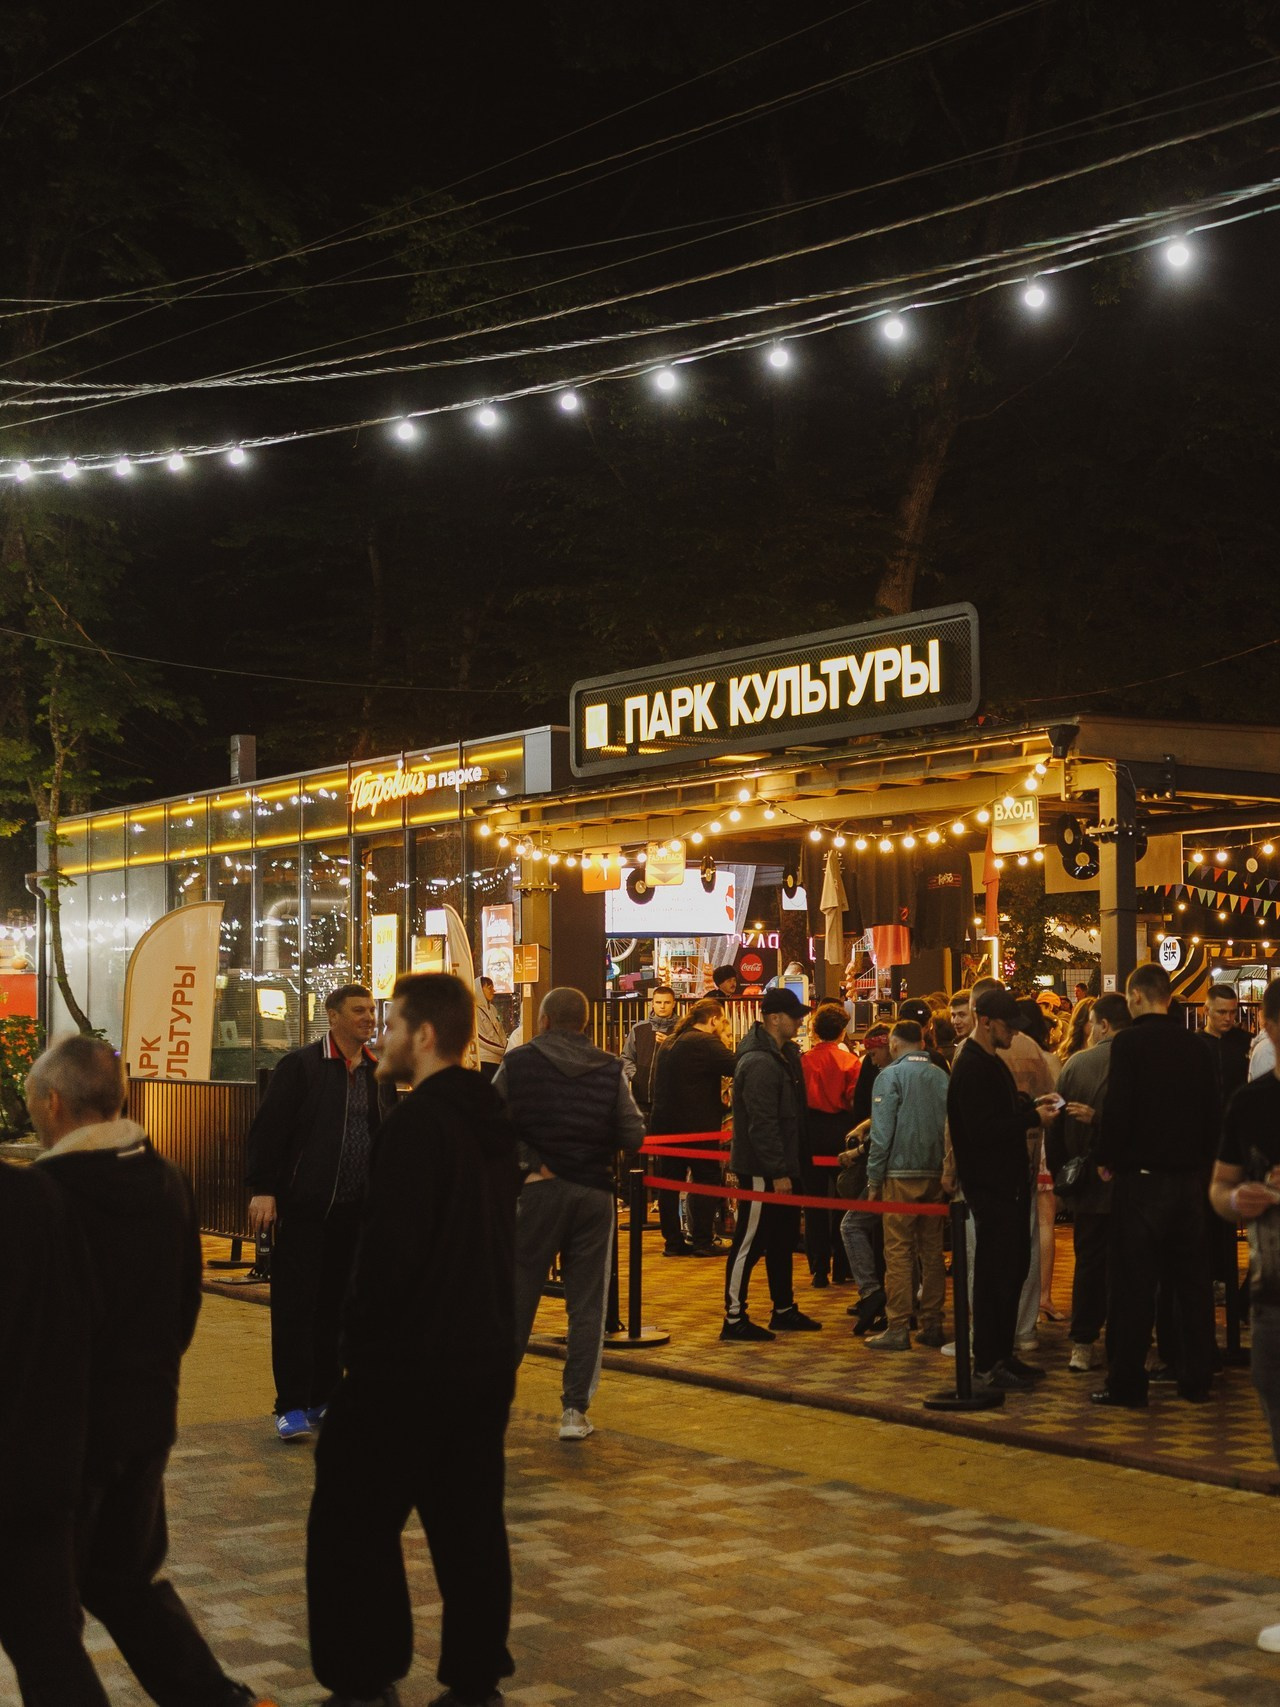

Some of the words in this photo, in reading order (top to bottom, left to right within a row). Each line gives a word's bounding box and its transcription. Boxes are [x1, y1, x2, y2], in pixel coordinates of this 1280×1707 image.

[624, 681, 718, 744] ПАРК
[729, 638, 941, 727] КУЛЬТУРЫ
[427, 774, 436, 789] в
[438, 766, 482, 793] парке
[994, 800, 1034, 820] ВХОД
